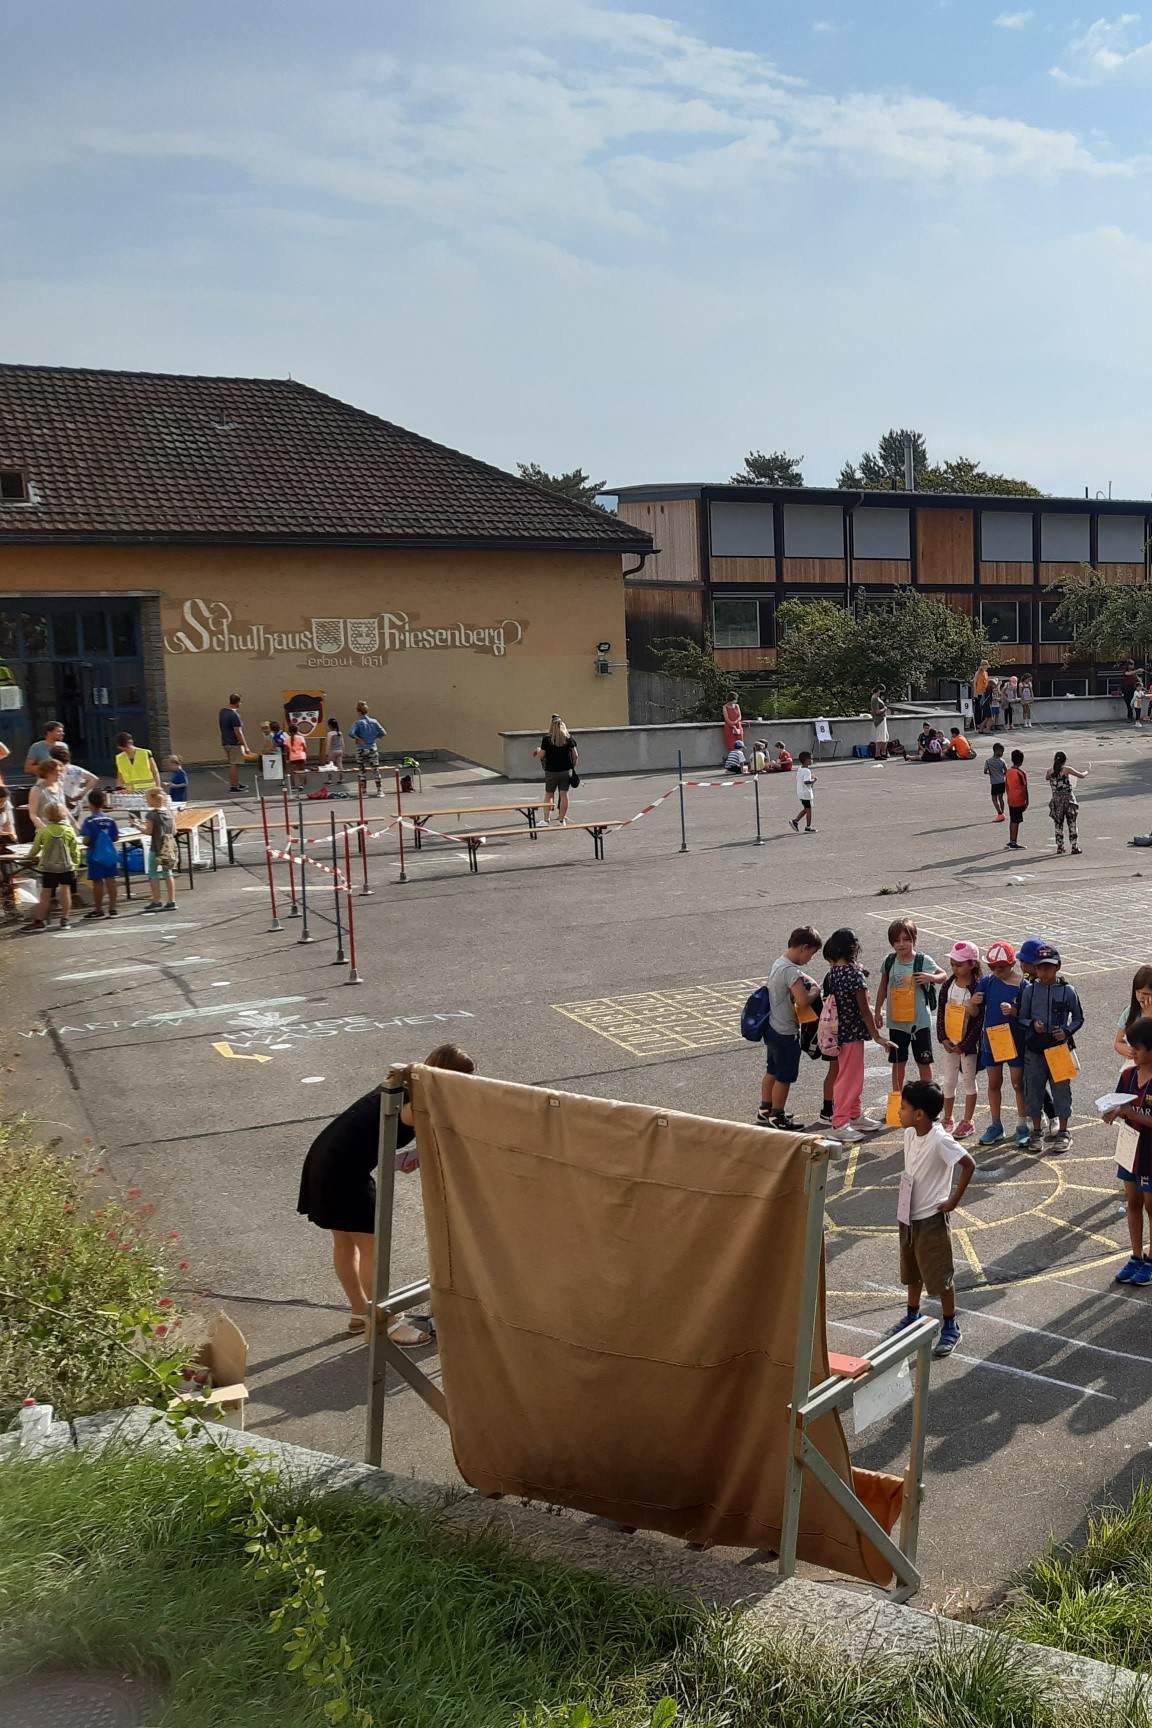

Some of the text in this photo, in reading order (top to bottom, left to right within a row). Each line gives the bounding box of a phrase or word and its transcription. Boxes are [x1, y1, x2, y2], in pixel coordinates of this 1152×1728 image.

[164, 598, 522, 657] Schulhaus Friesenberg
[308, 654, 355, 667] erbaut
[964, 702, 969, 710] 9
[820, 725, 826, 733] 8
[269, 759, 276, 769] 7
[17, 1018, 183, 1039] WARTEN
[226, 1009, 477, 1048] WASCHEN
